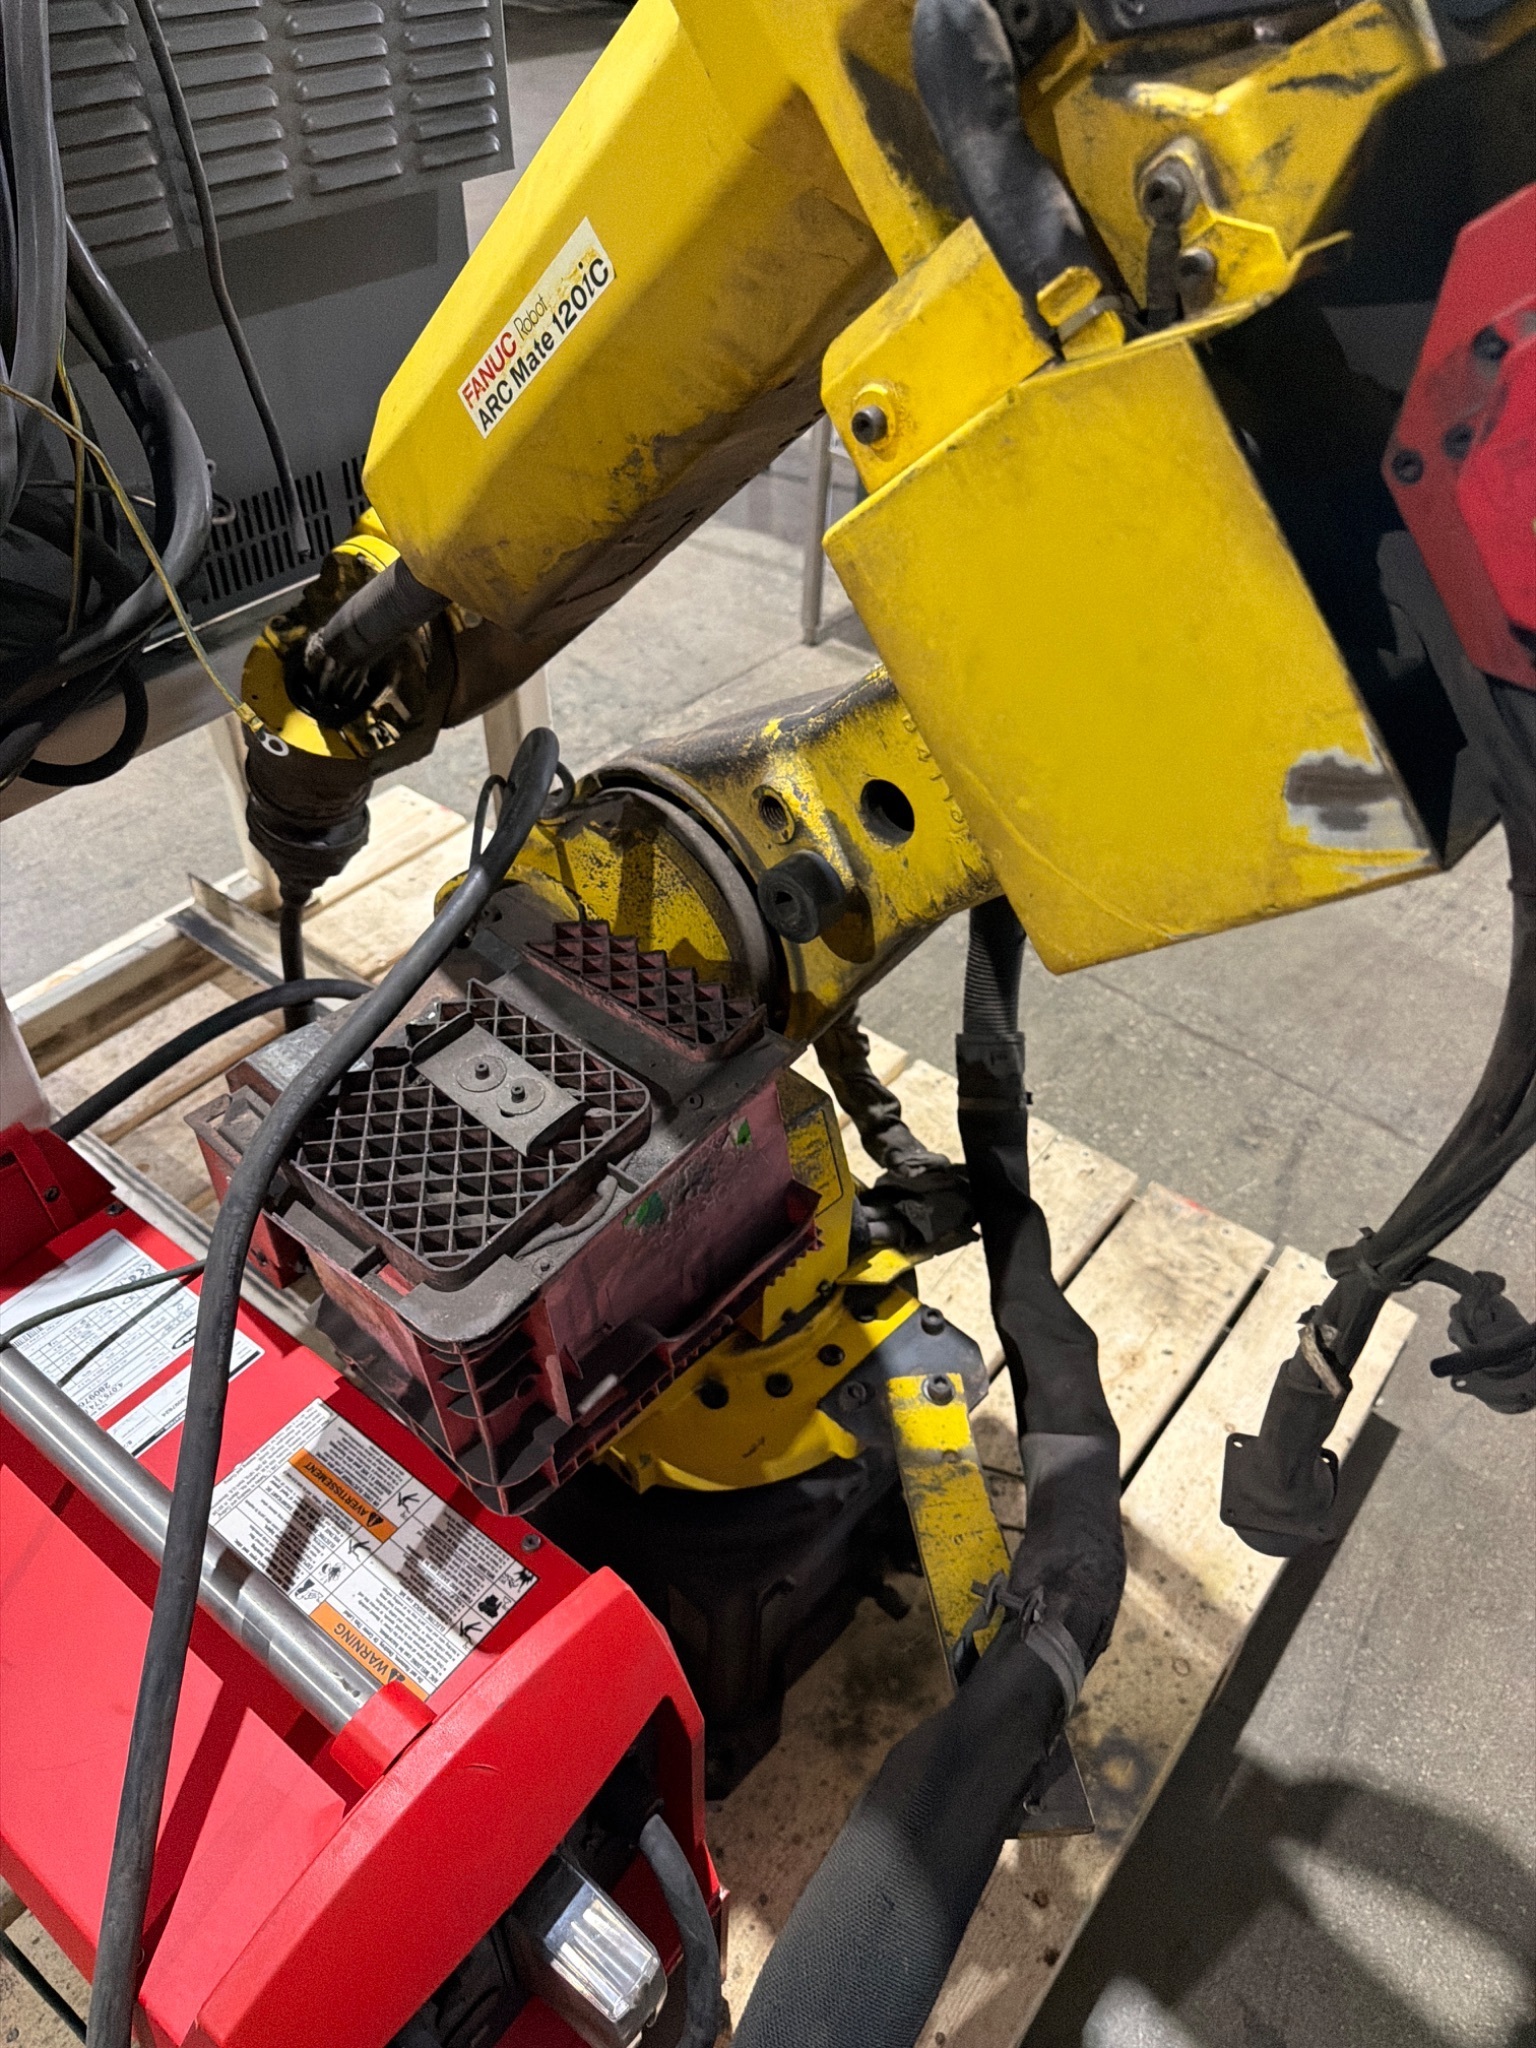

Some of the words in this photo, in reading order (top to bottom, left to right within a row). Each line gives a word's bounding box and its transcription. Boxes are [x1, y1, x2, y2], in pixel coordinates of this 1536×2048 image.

[462, 331, 517, 409] FANUC
[513, 295, 548, 341] Robot
[478, 380, 513, 432] ARC
[510, 330, 554, 388] Mate
[552, 258, 608, 335] 120iC
[304, 1462, 371, 1518] AVERTISSEMENT
[333, 1622, 388, 1674] WARNING
